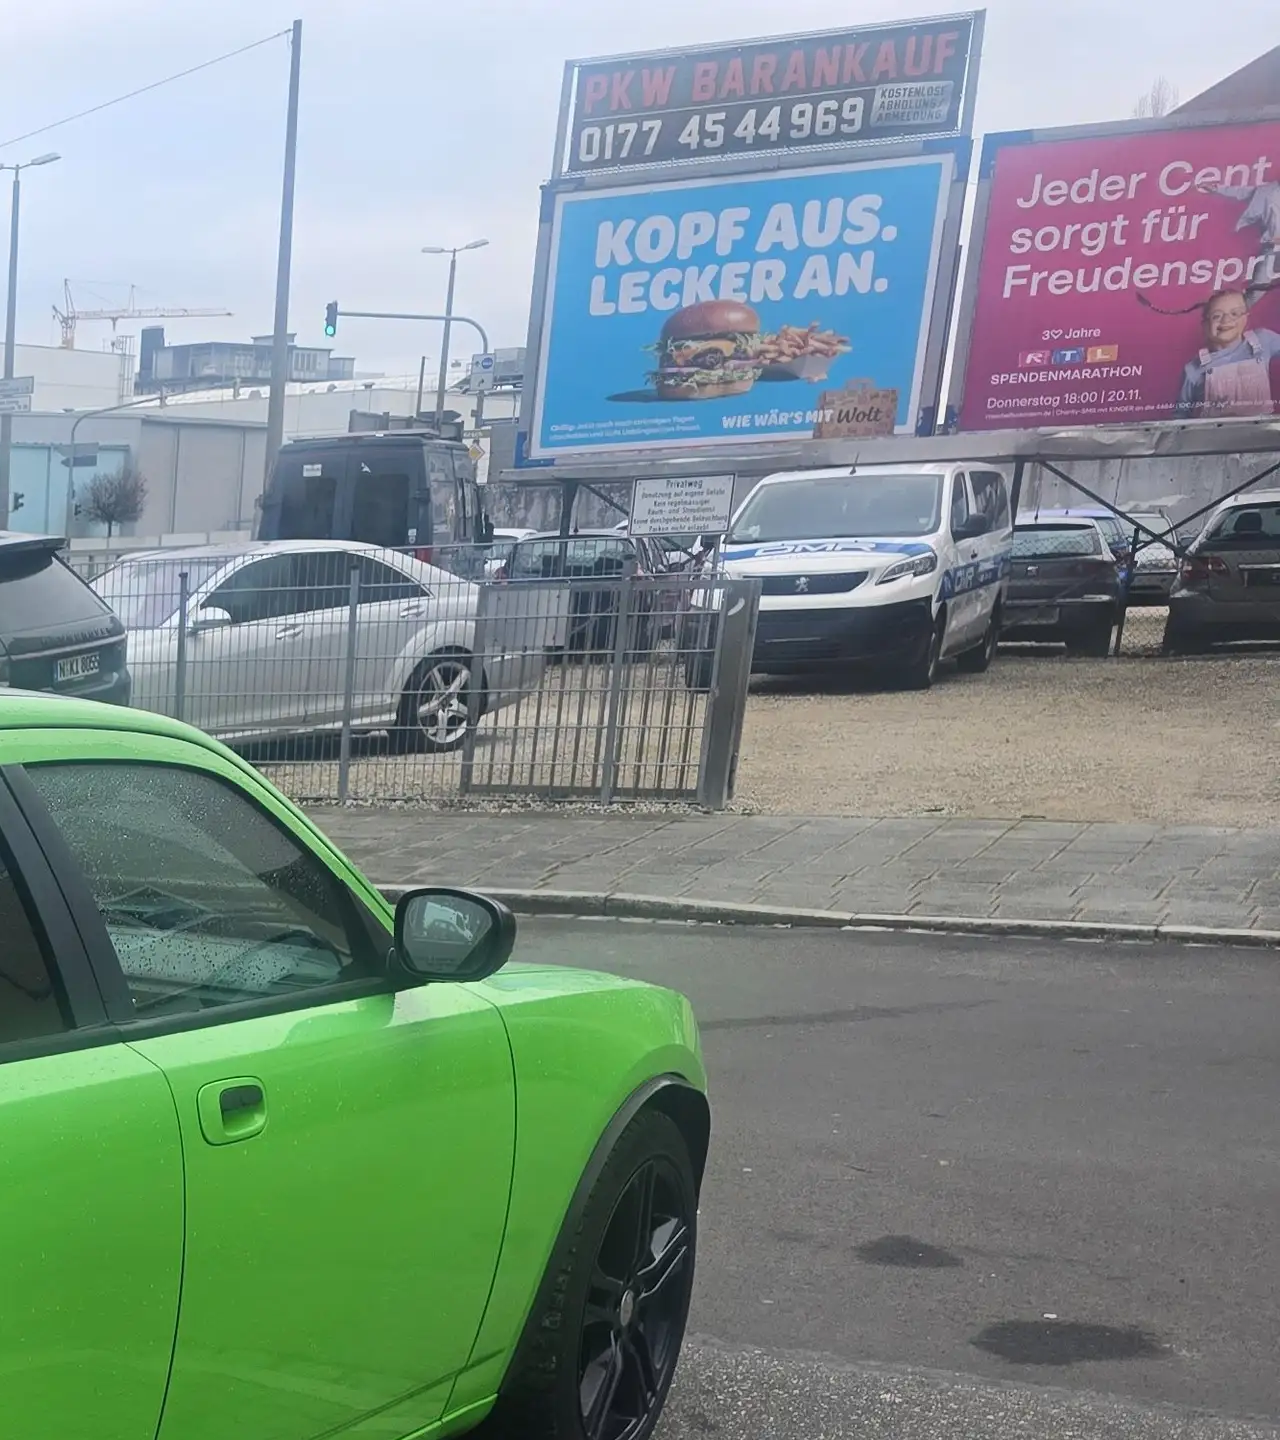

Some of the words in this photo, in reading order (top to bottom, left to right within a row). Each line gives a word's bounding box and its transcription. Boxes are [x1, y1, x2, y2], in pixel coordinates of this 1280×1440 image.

[585, 67, 678, 114] PKW
[692, 30, 962, 101] BARANKAUF
[579, 120, 664, 162] 0177
[678, 112, 727, 150] 45
[734, 103, 781, 144] 44
[790, 96, 865, 140] 969
[1016, 167, 1147, 209] Jeder
[1158, 155, 1273, 197] Cent
[594, 206, 751, 269] KOPF
[754, 193, 898, 254] AUS.
[1009, 213, 1130, 257] sorgt
[1141, 204, 1209, 244] für
[589, 261, 786, 316] LECKER
[793, 250, 888, 300] AN.
[1022, 347, 1115, 365] RTL
[1064, 327, 1101, 340] Jahre
[986, 395, 1061, 411] Donnerstag
[1063, 391, 1098, 404] 18:00
[1107, 389, 1142, 402] 20.11.
[990, 365, 1143, 386] SPENDENMARATHON
[722, 415, 751, 428] WIE
[755, 409, 802, 426] WÄR'S
[805, 409, 834, 423] MIT
[837, 406, 883, 423] Wolt
